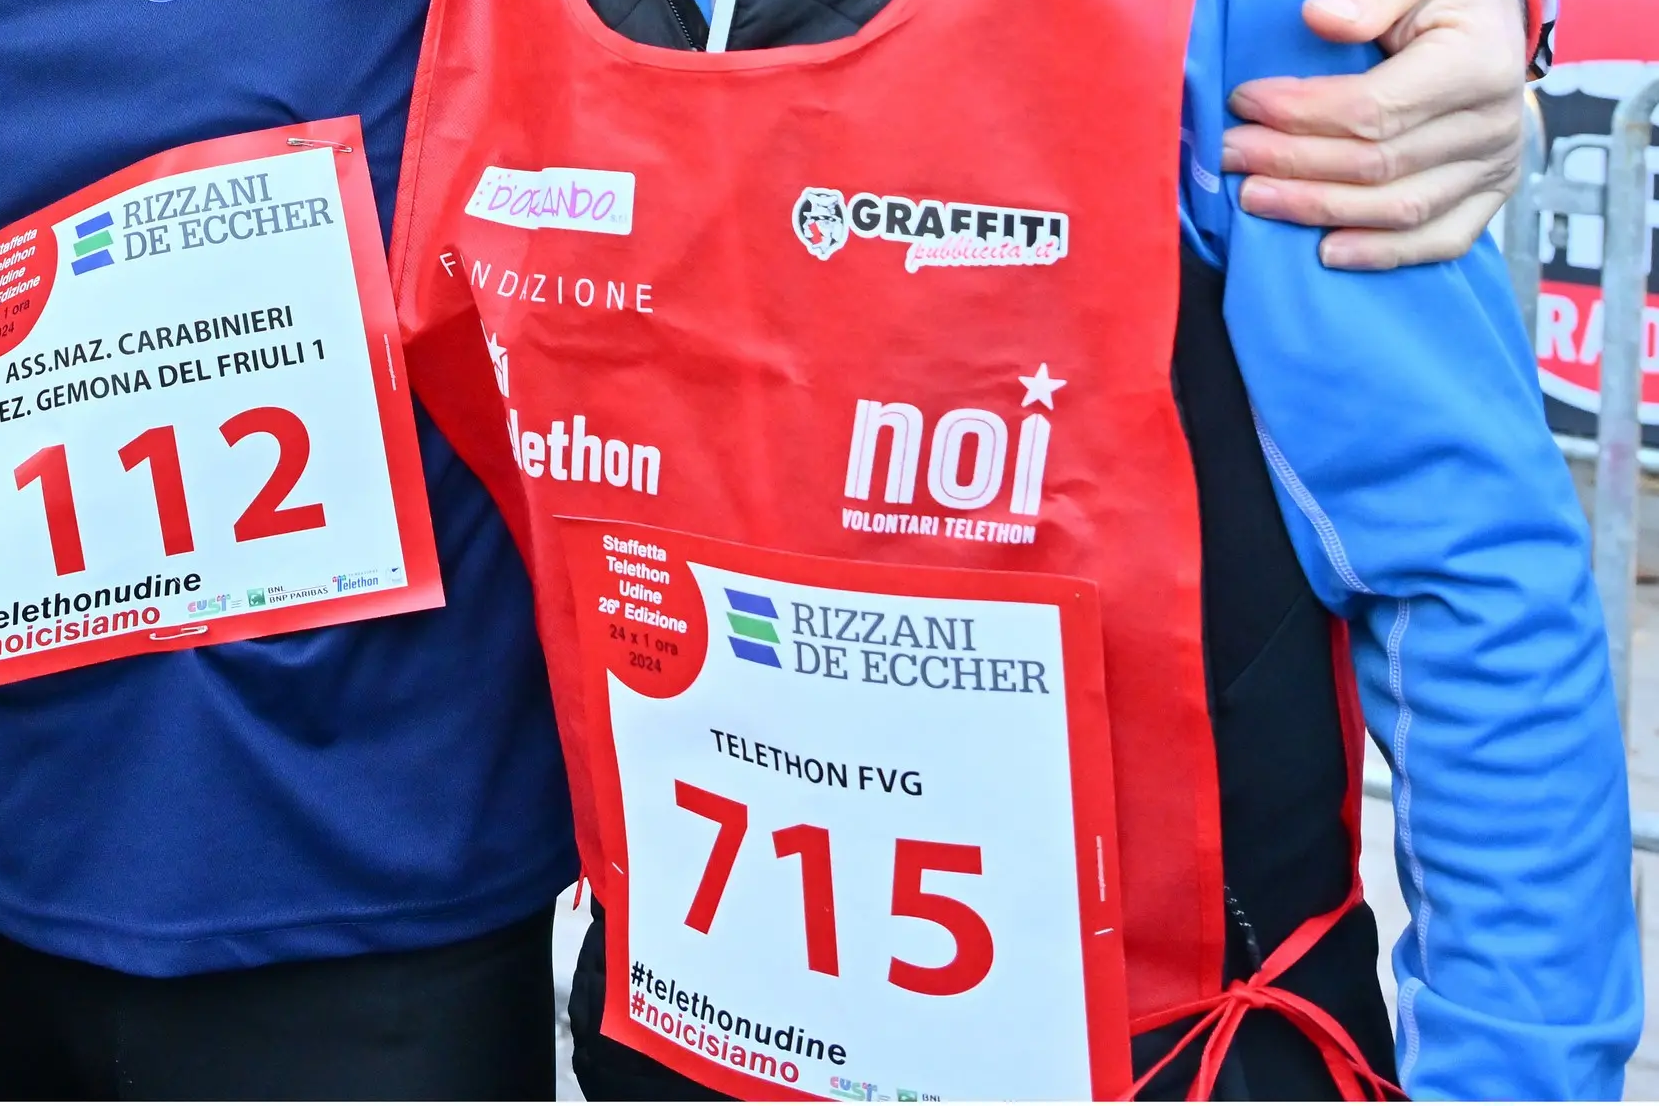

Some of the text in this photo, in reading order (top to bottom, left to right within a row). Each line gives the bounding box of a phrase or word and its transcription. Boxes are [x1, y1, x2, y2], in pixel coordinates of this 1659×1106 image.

[123, 173, 270, 229] RIZZANI
[852, 198, 1061, 251] GRAFFITI
[124, 197, 333, 261] DE ECCHER
[4, 307, 8, 319] 1
[12, 299, 30, 315] ora
[118, 305, 294, 356] CARABINIERI
[36, 369, 152, 411] GEMONA
[158, 361, 212, 387] DEL
[218, 342, 306, 377] FRIULI
[312, 338, 325, 360] 1
[506, 406, 661, 496] lethon
[842, 362, 1067, 515] noi
[13, 406, 326, 577] 112
[602, 534, 667, 562] Staffetta
[842, 508, 1036, 544] VOLONTARI TELETHON
[267, 585, 285, 594] BNL
[332, 574, 379, 592] Telethon
[606, 555, 670, 584] Telethon
[619, 580, 662, 605] Udine
[269, 587, 329, 604] BNP PARIBAS
[625, 603, 687, 633] Edizione
[610, 624, 678, 655] 24 x 1 ora
[791, 602, 975, 651] RIZZANI
[630, 652, 662, 673] 2024
[795, 640, 1050, 695] DE ECCHER
[710, 728, 923, 796] TELETHON FVG
[673, 779, 994, 997] 715
[631, 960, 847, 1066] #telethonudine
[631, 991, 799, 1084] #noicisiamo
